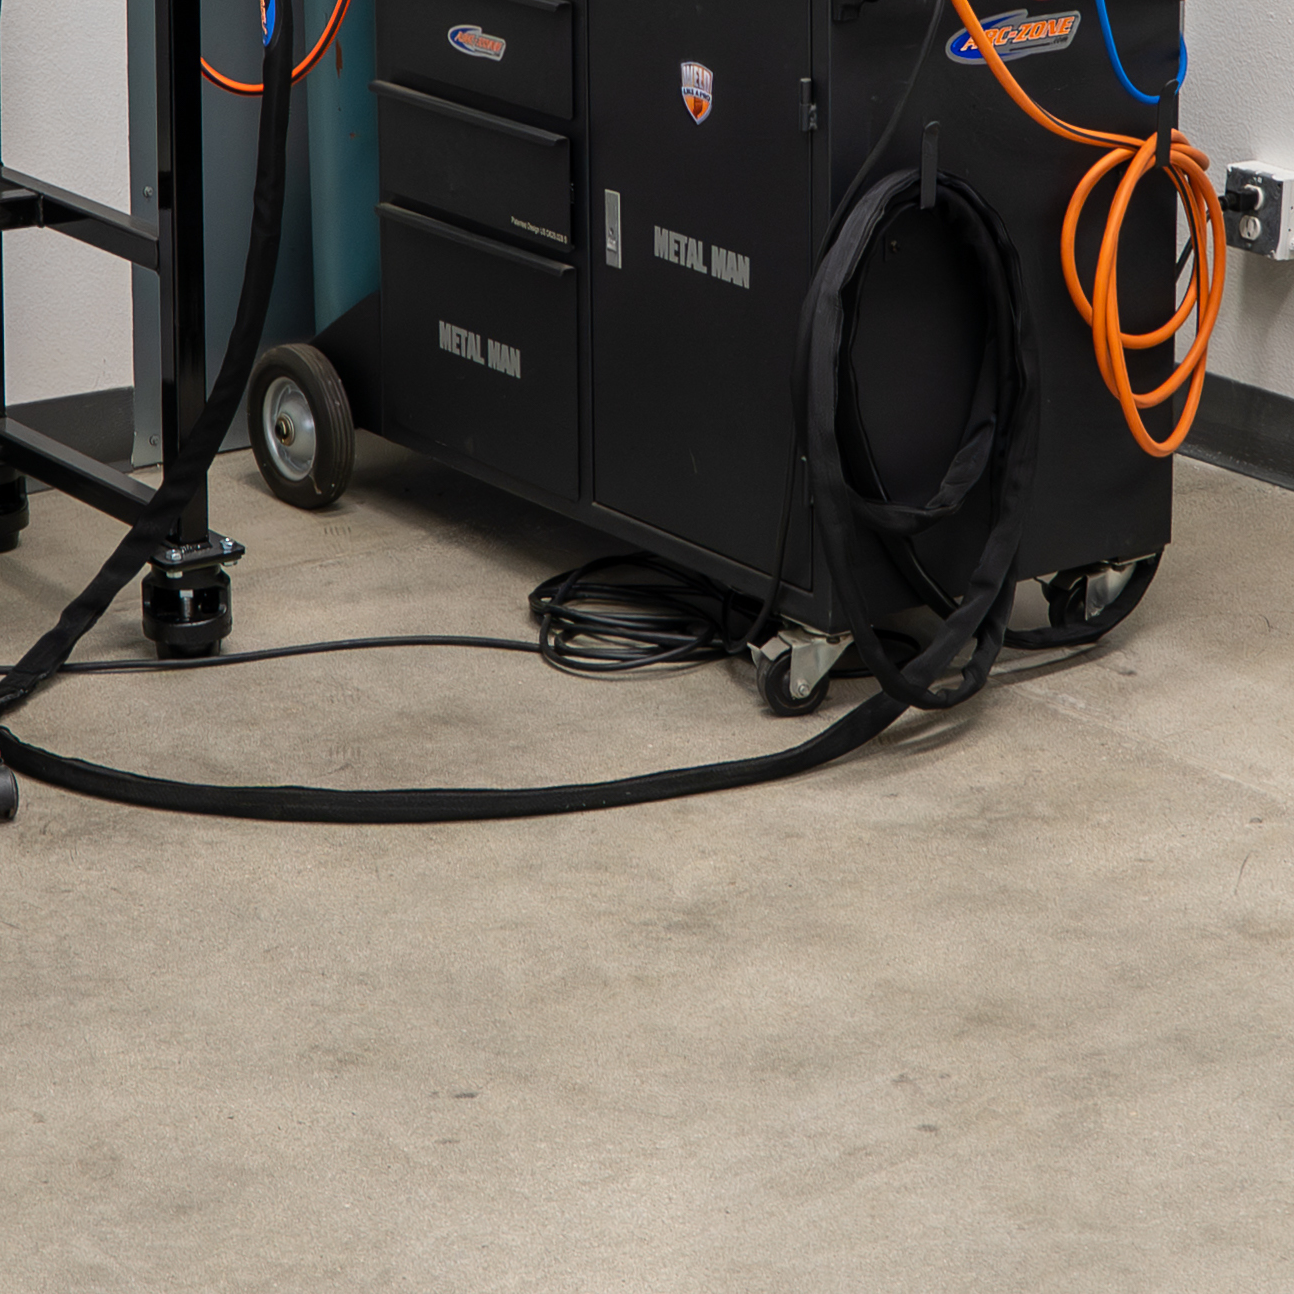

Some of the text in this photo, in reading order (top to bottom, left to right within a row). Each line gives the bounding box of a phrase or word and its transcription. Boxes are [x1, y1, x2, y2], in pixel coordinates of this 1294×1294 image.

[683, 65, 711, 94] WELD
[654, 225, 750, 290] METAL MAN
[439, 319, 521, 380] METAL MAN
